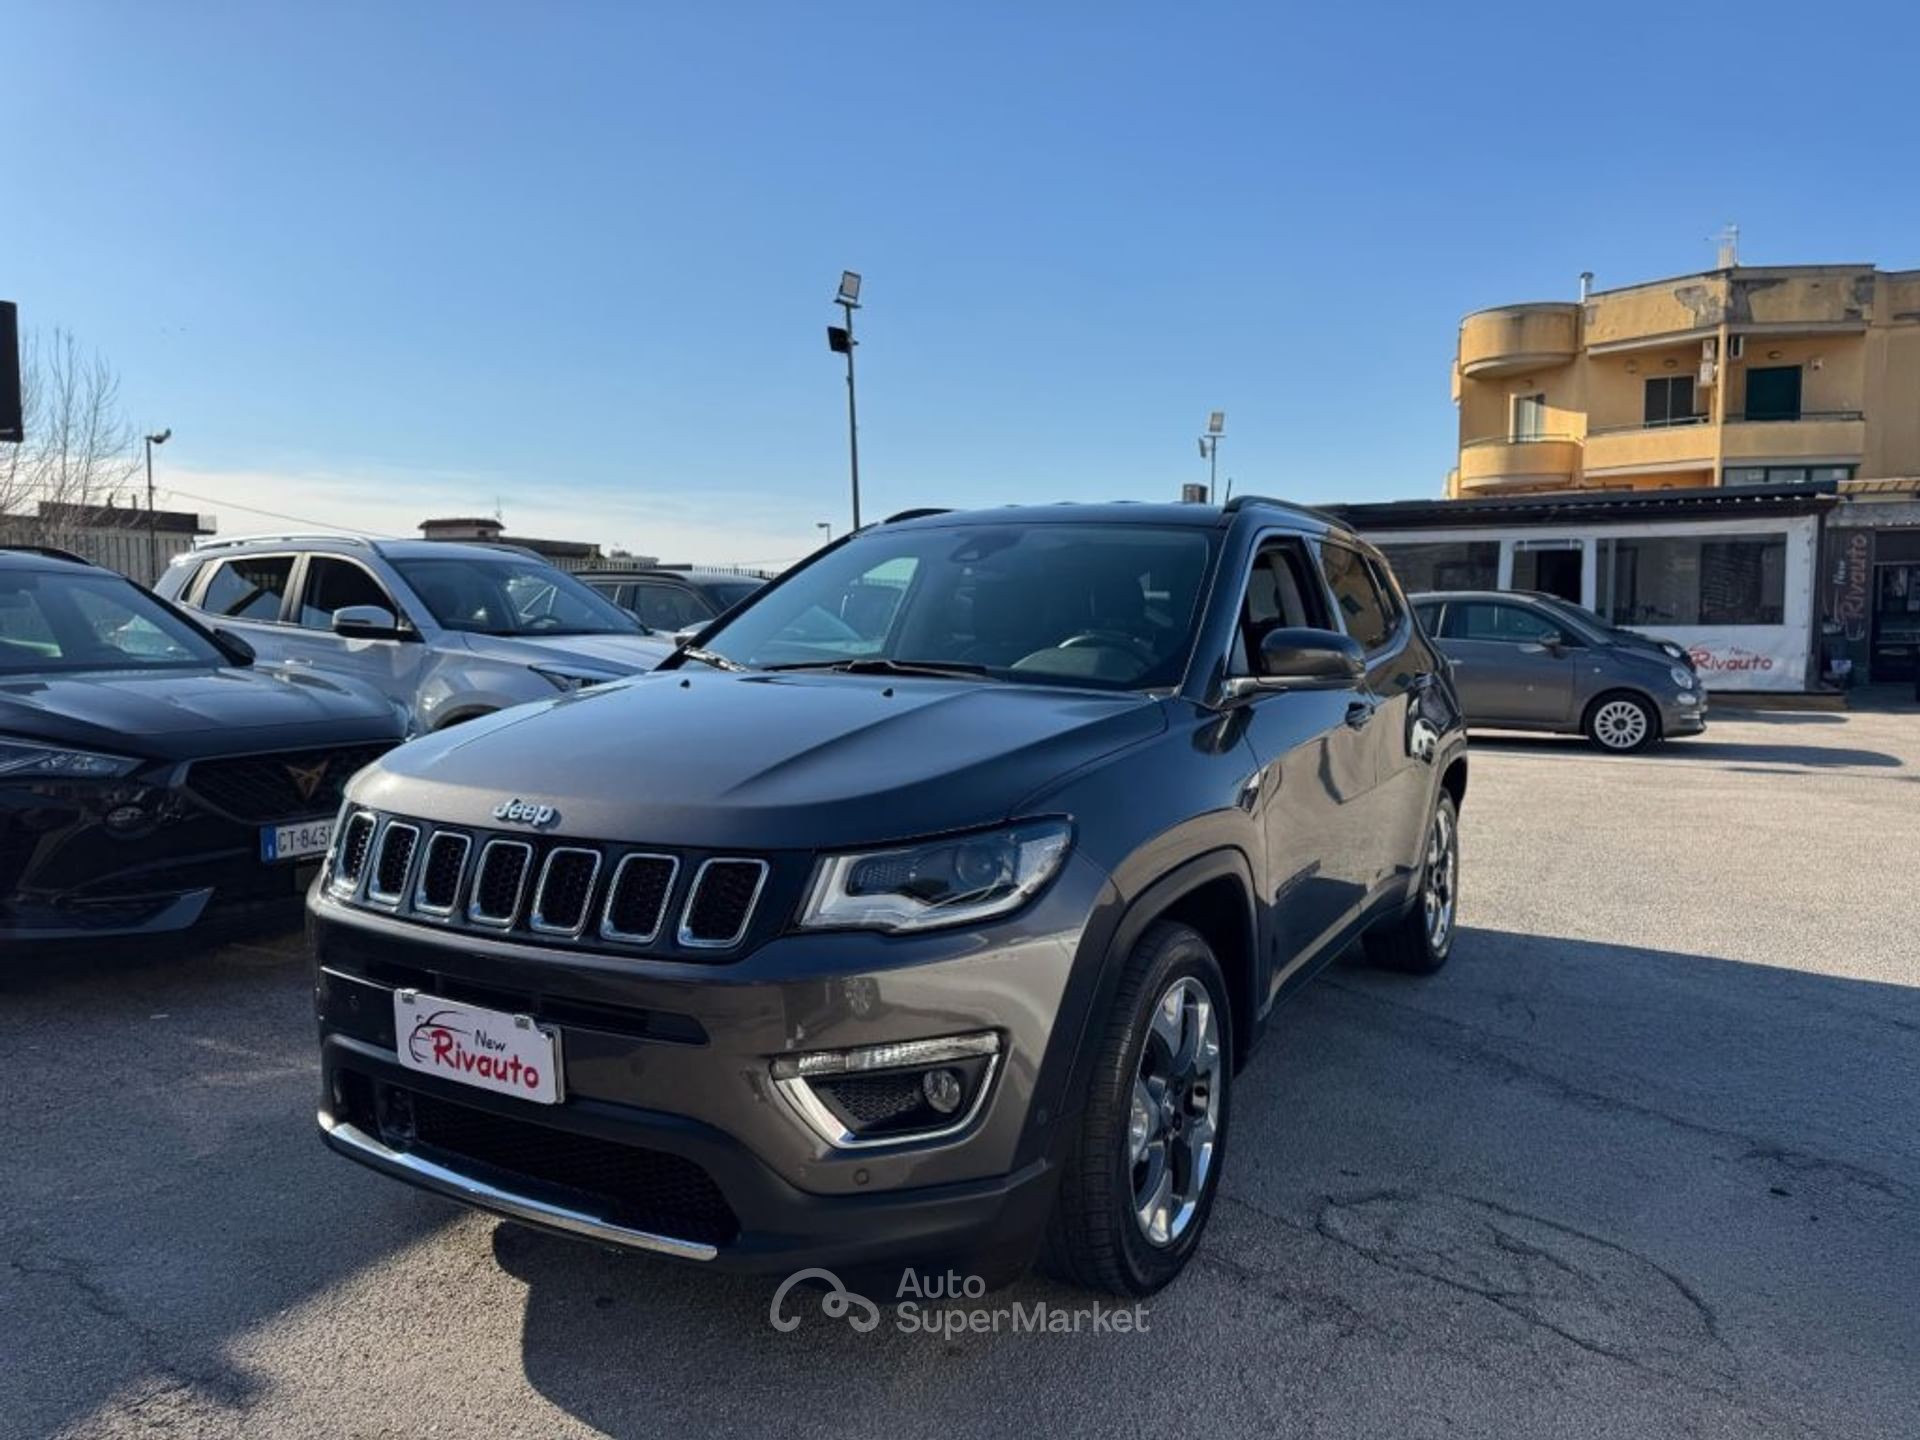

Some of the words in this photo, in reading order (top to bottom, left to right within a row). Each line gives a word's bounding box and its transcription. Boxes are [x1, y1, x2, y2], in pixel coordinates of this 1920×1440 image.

[1695, 650, 1773, 671] Rivauto
[492, 801, 554, 827] Jeep
[474, 1029, 506, 1052] New
[430, 1028, 539, 1089] Rivauto
